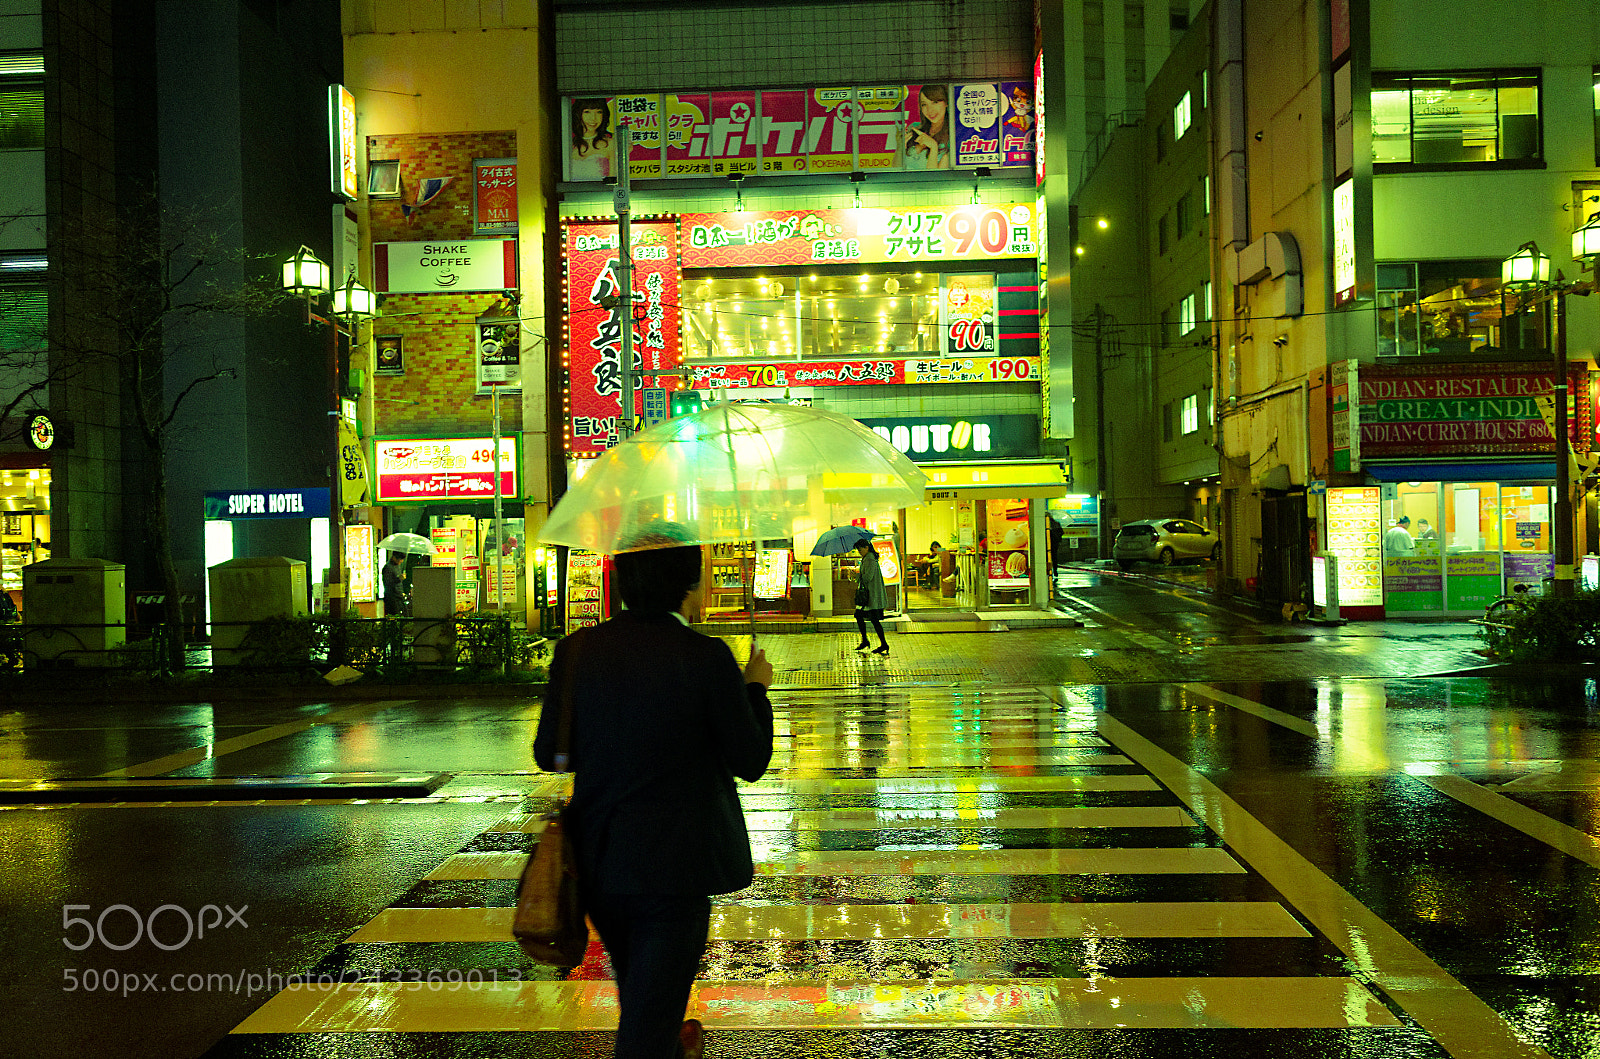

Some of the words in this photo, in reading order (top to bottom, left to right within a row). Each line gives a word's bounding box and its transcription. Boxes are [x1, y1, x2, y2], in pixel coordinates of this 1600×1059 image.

[618, 98, 656, 112] 池袋で
[964, 107, 993, 115] 求人情報
[620, 113, 694, 129] キャバクラ
[632, 131, 682, 141] 探すなら!!
[860, 158, 891, 167] STUDIO
[481, 167, 513, 178] タイ古式
[478, 179, 516, 189] マッサージ
[488, 208, 509, 219] MAI
[887, 214, 943, 235] クリア
[948, 211, 1009, 254] 90
[1013, 227, 1028, 242] 円
[423, 245, 468, 255] SHAKE
[812, 239, 861, 259] 居酒屋
[886, 236, 943, 256] アサヒ
[420, 257, 472, 267] COFFEE
[949, 318, 985, 350] 90
[837, 361, 896, 384] 八五郎
[916, 361, 963, 374] 生ビール
[988, 359, 1030, 380] 190
[747, 365, 779, 387] 70
[573, 416, 616, 437] 旨い!
[1417, 422, 1473, 443] CURRY
[1475, 421, 1526, 441] HOUSE
[228, 494, 266, 514] SUPER
[268, 493, 305, 513] HOTEL
[584, 589, 598, 598] 70
[583, 603, 597, 613] 90
